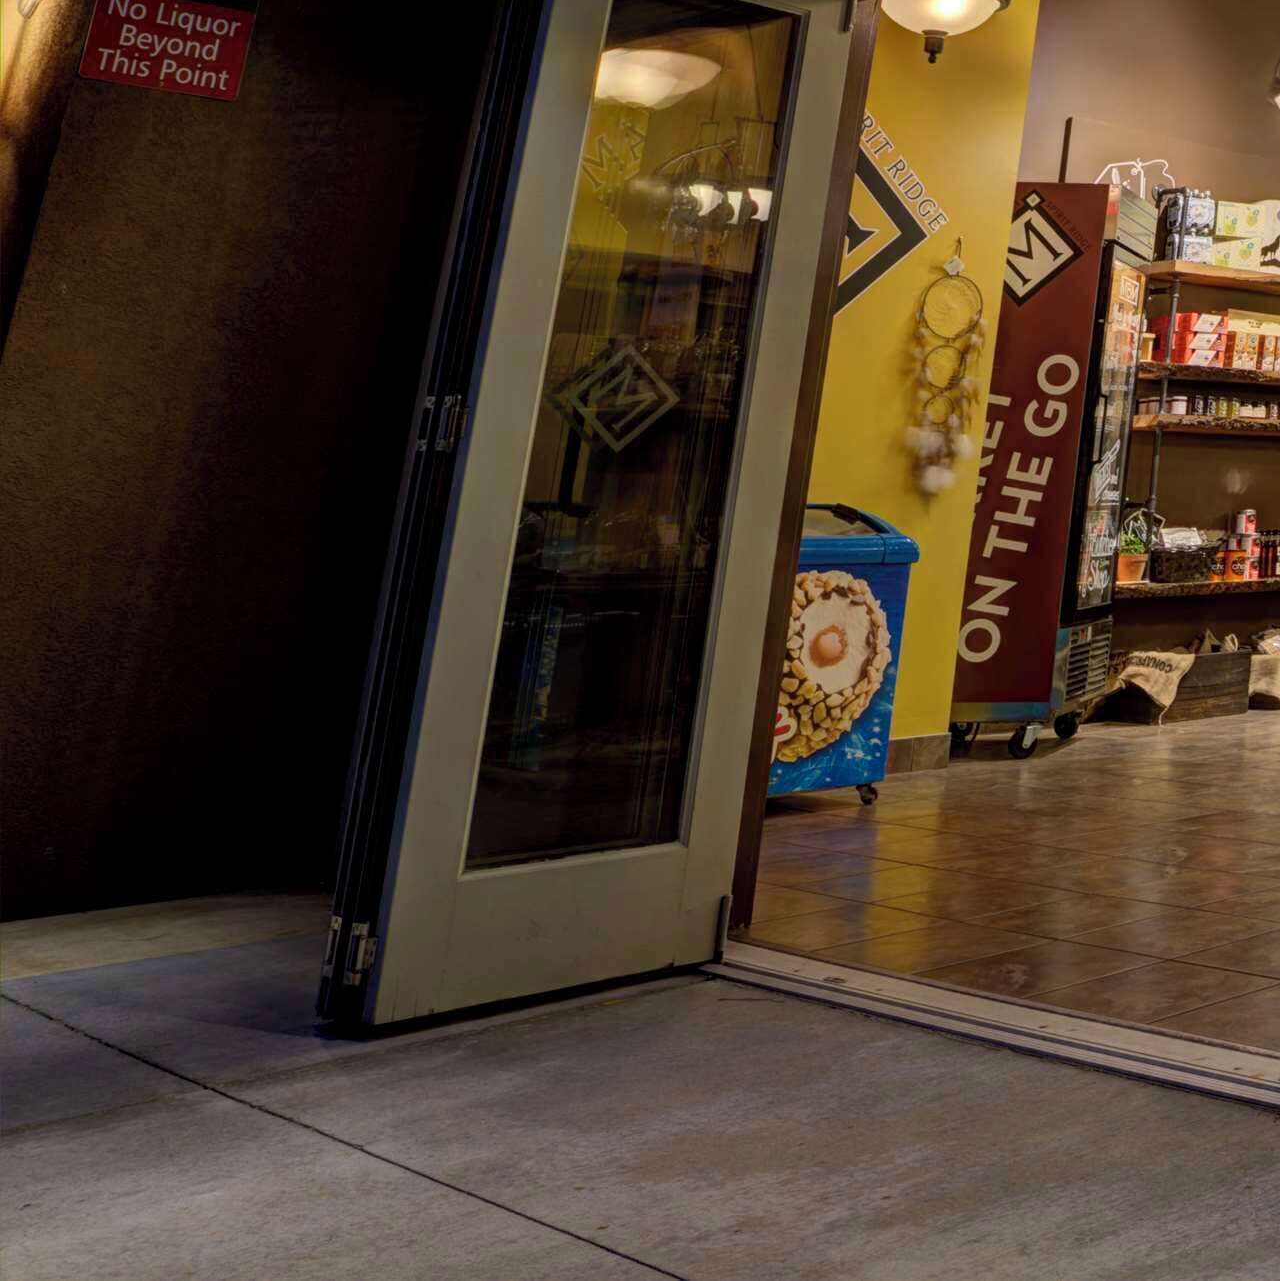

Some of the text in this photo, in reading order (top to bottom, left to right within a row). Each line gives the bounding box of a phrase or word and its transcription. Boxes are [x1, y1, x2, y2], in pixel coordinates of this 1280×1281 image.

[156, 2, 241, 38] Liquor
[119, 23, 220, 62] Beyond
[98, 48, 230, 91] This Point
[887, 159, 949, 232] RIDGE
[958, 354, 1080, 663] ON THE GO
